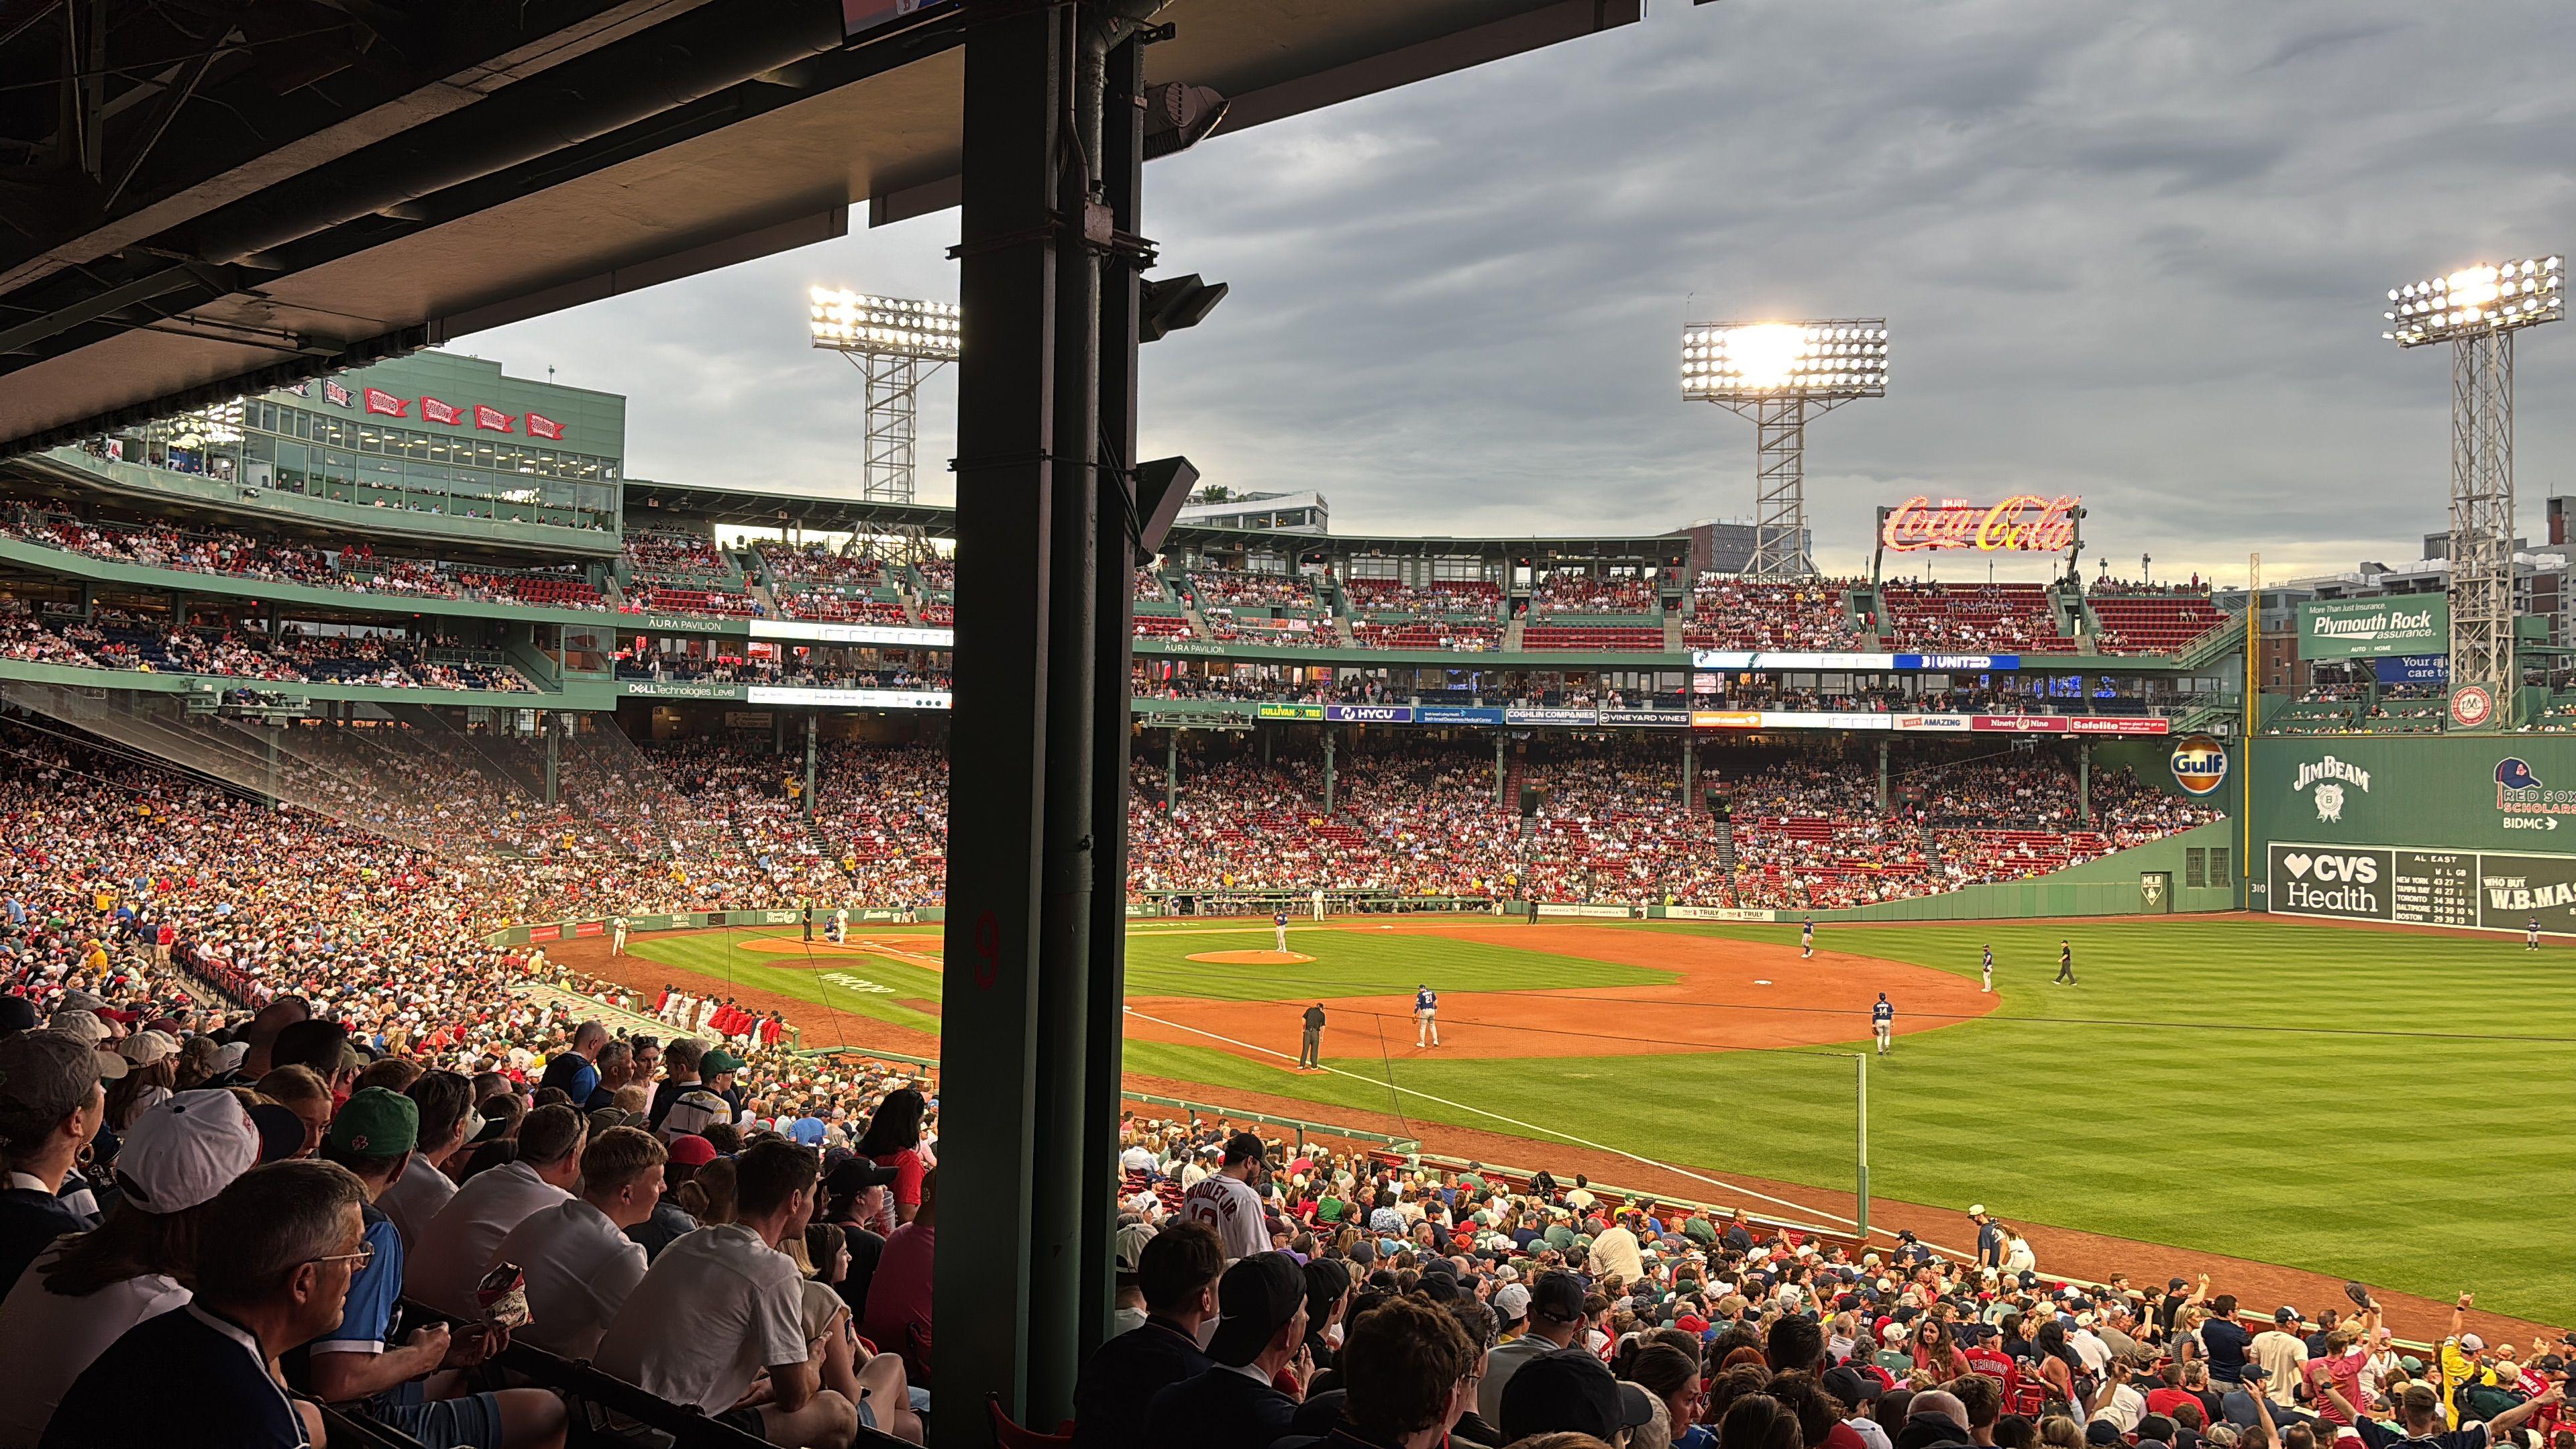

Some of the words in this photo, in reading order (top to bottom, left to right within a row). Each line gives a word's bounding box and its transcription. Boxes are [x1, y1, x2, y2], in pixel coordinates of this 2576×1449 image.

[370, 394, 398, 411] 2004
[426, 403, 453, 419] 2007
[480, 411, 504, 427] 2013
[1942, 499, 1968, 508] ENJOY
[2309, 606, 2325, 614] More
[2326, 604, 2341, 612] Than
[2342, 604, 2354, 612] Just
[681, 621, 721, 631] PAVILION
[2314, 613, 2386, 635] Plymouth
[2390, 610, 2432, 629] Rock
[1191, 645, 1224, 654] PAVILION
[1937, 655, 1992, 668] UNITED
[2402, 657, 2429, 667] Your
[2408, 670, 2433, 678] care
[656, 684, 711, 697] Technologies
[714, 687, 735, 696] Level
[1261, 708, 1295, 716] SULLIVAN
[1358, 709, 1393, 719] HYCU
[1924, 718, 1961, 727] AMAZING
[1990, 719, 2016, 728] Ninety
[2030, 719, 2049, 727] Nine
[2073, 720, 2118, 730] Safelite
[2173, 754, 2223, 773] Gulf
[2504, 790, 2538, 802] RED
[2503, 817, 2544, 830] BIDMC
[2430, 855, 2457, 863] EAST
[2314, 855, 2377, 883] CVS
[2455, 869, 2466, 877] GB
[2483, 878, 2506, 887] WHO
[2507, 879, 2526, 888] BUT
[2251, 883, 2266, 894] 310
[2287, 881, 2378, 912] Health
[2396, 895, 2428, 903] TORONTO
[2396, 904, 2431, 912] BALTIMORE
[863, 910, 892, 920] Franklin
[2396, 913, 2422, 921] BOSTON
[2445, 916, 2455, 924] 39
[974, 908, 1000, 992] 9
[1186, 1181, 1229, 1204] BRADLEY
[1970, 1358, 2008, 1376] ERDUGO
